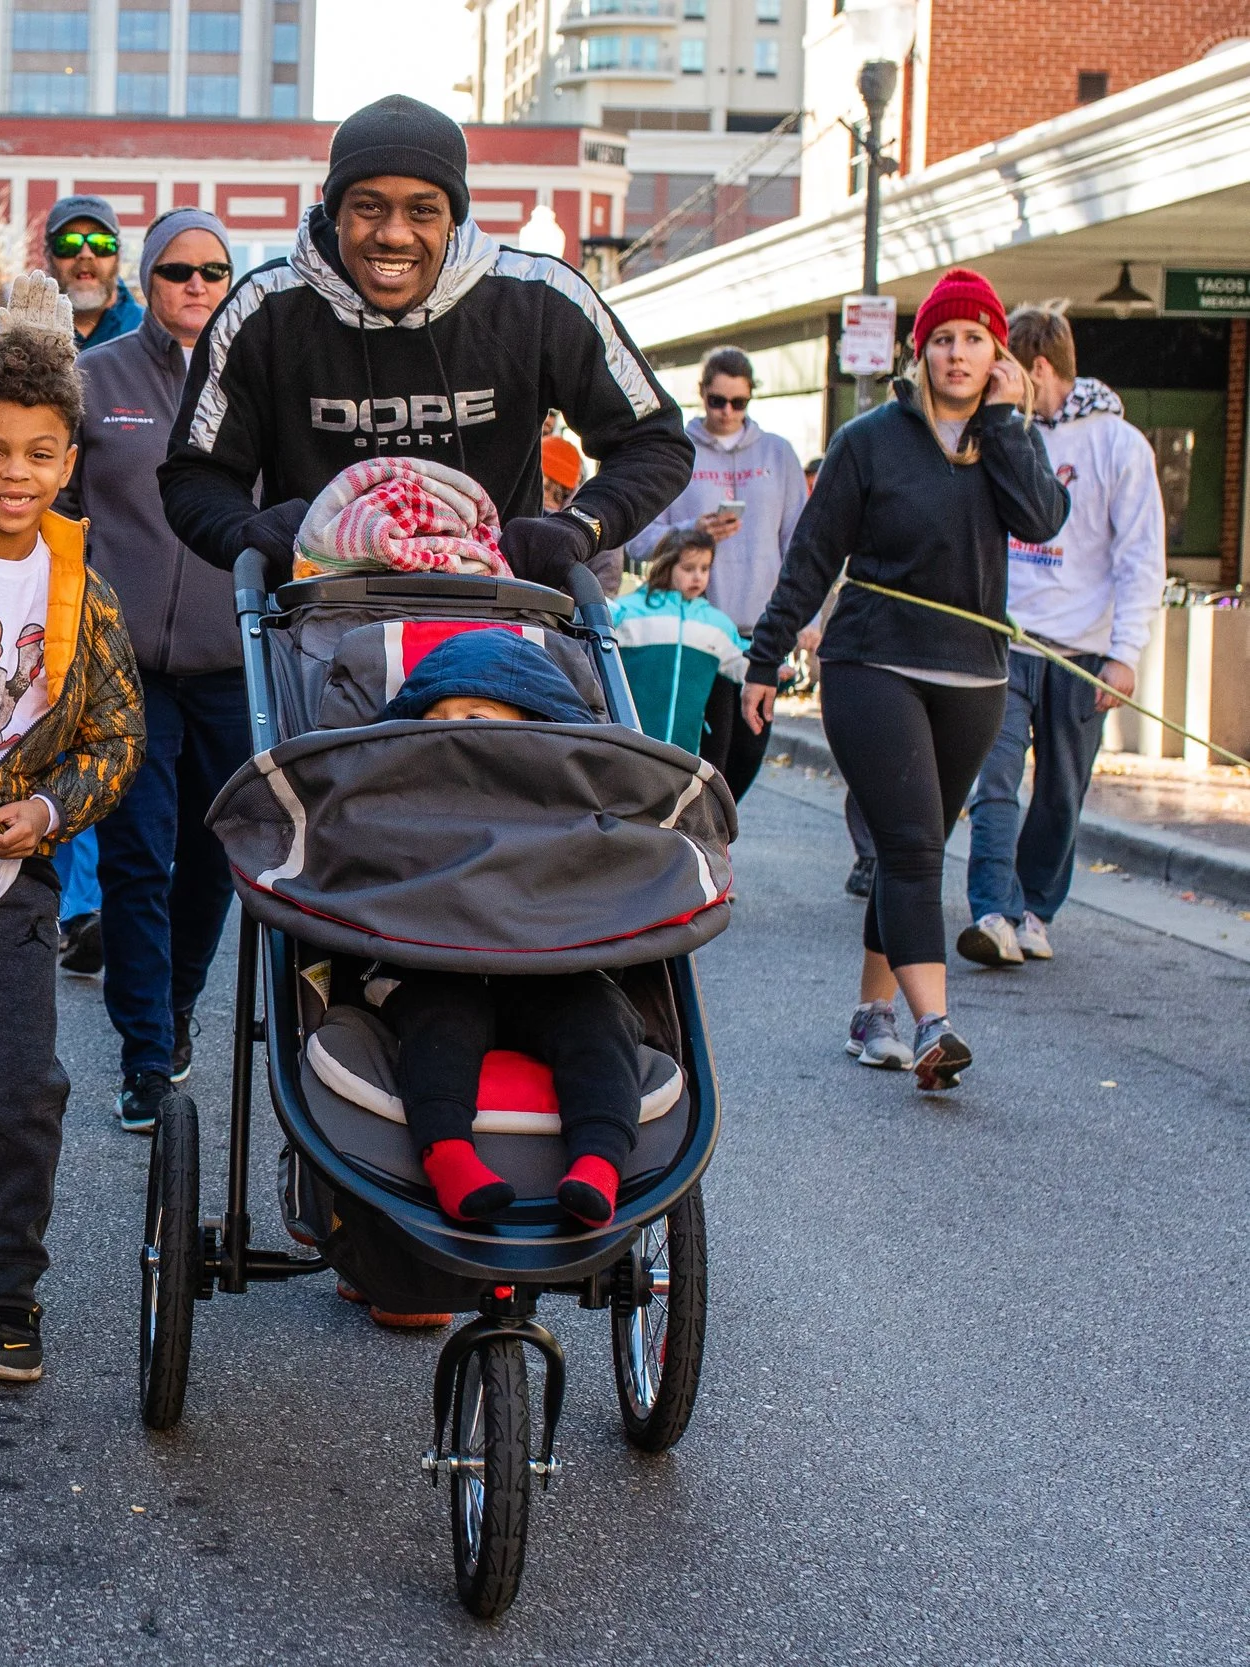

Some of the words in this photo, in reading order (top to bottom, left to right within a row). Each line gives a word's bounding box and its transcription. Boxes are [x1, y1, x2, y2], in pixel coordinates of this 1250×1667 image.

[1196, 277, 1246, 294] TACOS
[310, 388, 496, 433] DOPE
[354, 433, 453, 447] SPORT
